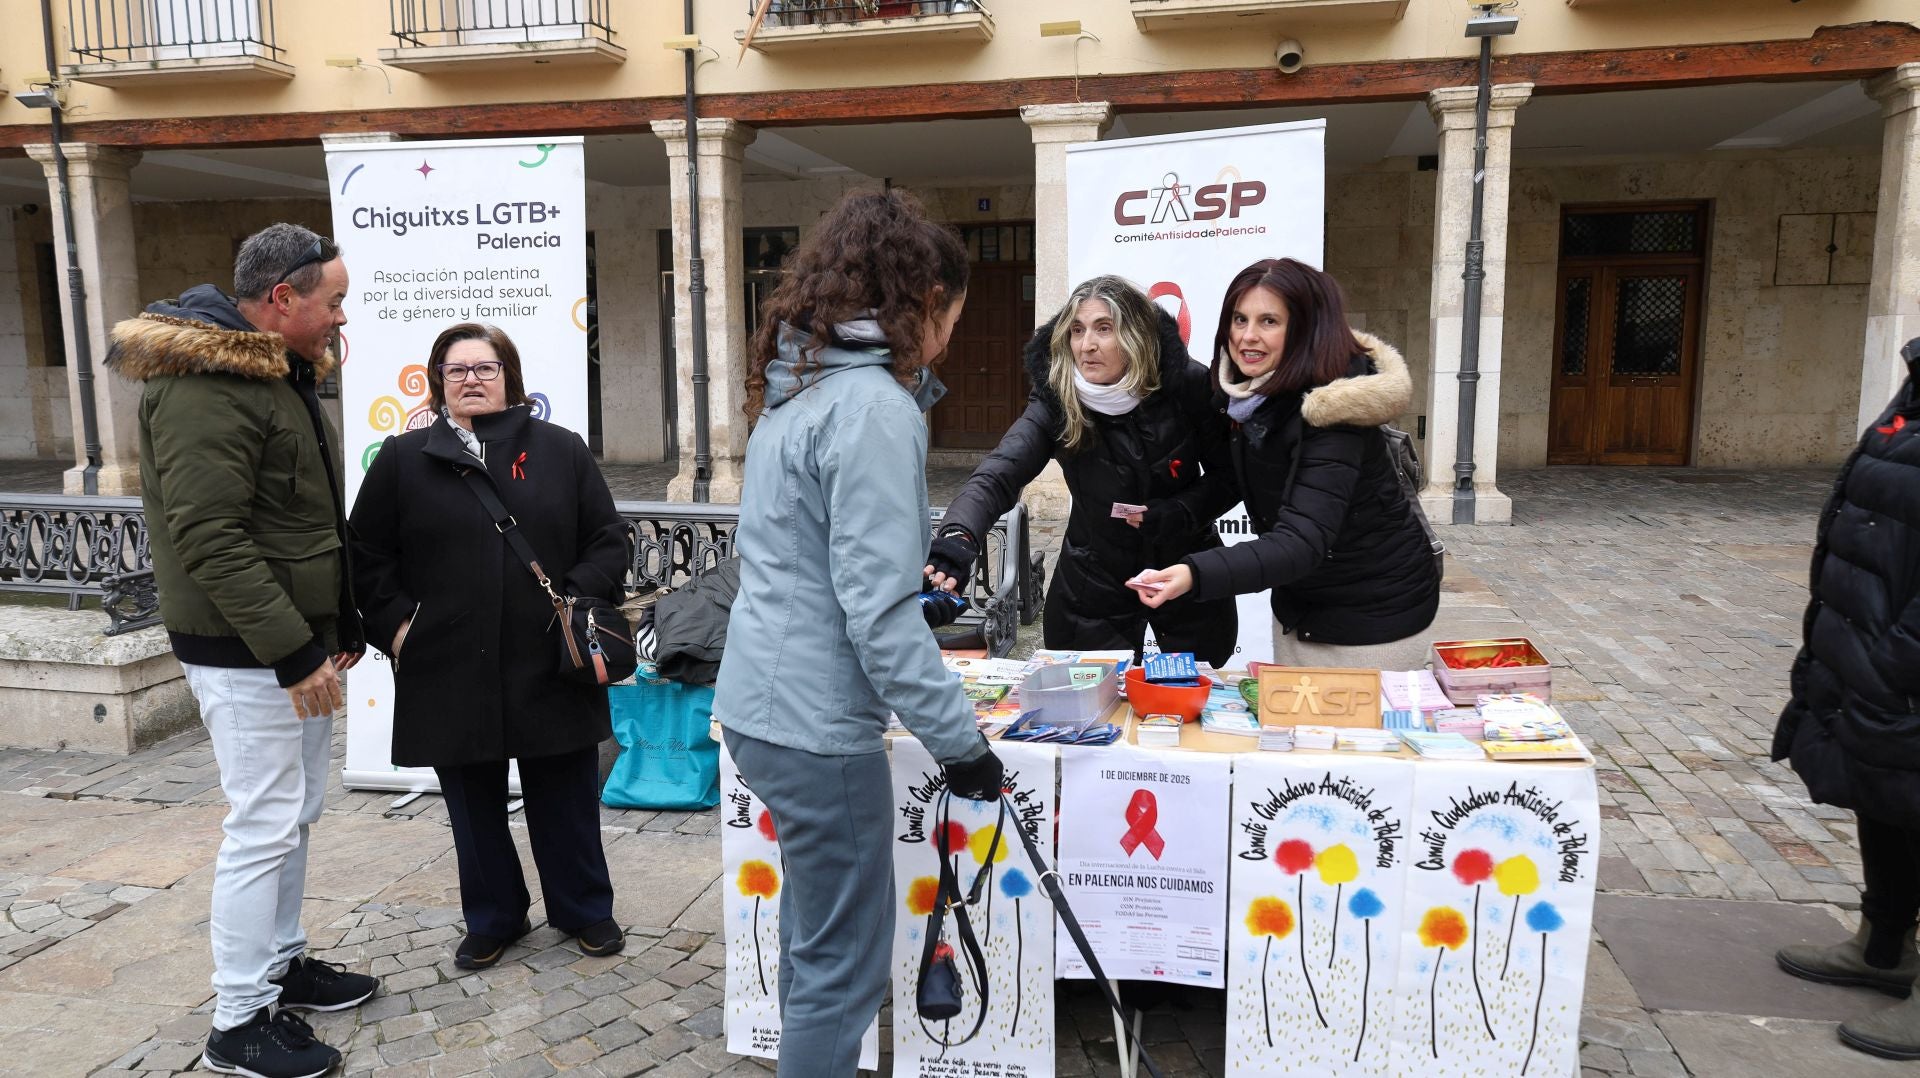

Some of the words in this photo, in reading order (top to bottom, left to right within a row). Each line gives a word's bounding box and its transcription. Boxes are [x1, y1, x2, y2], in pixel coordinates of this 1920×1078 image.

[1114, 174, 1267, 226] CASP
[352, 206, 469, 236] Chiguitxs
[476, 201, 561, 225] LGTB+
[1114, 225, 1266, 243] ComitéAntisidadePalencia
[477, 232, 561, 250] Palencia
[374, 268, 458, 283] Asociación
[463, 266, 540, 284] palentina
[363, 290, 388, 305] por
[393, 288, 409, 301] la
[414, 285, 494, 301] diversidad
[499, 284, 552, 299] sexual,
[378, 307, 398, 320] de
[403, 305, 455, 322] género
[460, 308, 470, 320] y
[475, 303, 538, 318] familiar
[1073, 672, 1097, 680] CASP
[1265, 676, 1375, 716] CASP
[1100, 770, 1104, 779] 1
[1106, 770, 1115, 780] DE
[1117, 771, 1157, 782] DICIEMBRE
[1159, 773, 1169, 783] DE
[1171, 774, 1191, 785] 2025
[727, 788, 753, 829] Comité
[898, 801, 926, 843] Comité
[1014, 788, 1036, 807] de
[1250, 777, 1316, 821] Ciudadano
[1367, 806, 1393, 824] de
[1431, 785, 1500, 829] Ciudadano
[1238, 818, 1268, 861] Comité
[1373, 819, 1403, 869] Palencia
[1553, 820, 1580, 837] de
[1414, 826, 1447, 871] Comité
[1557, 833, 1589, 883] Palencia
[1068, 873, 1082, 886] EN
[1085, 874, 1134, 888] PALENCIA
[1137, 876, 1157, 890] NOS
[1160, 877, 1214, 894] CUIDAMOS
